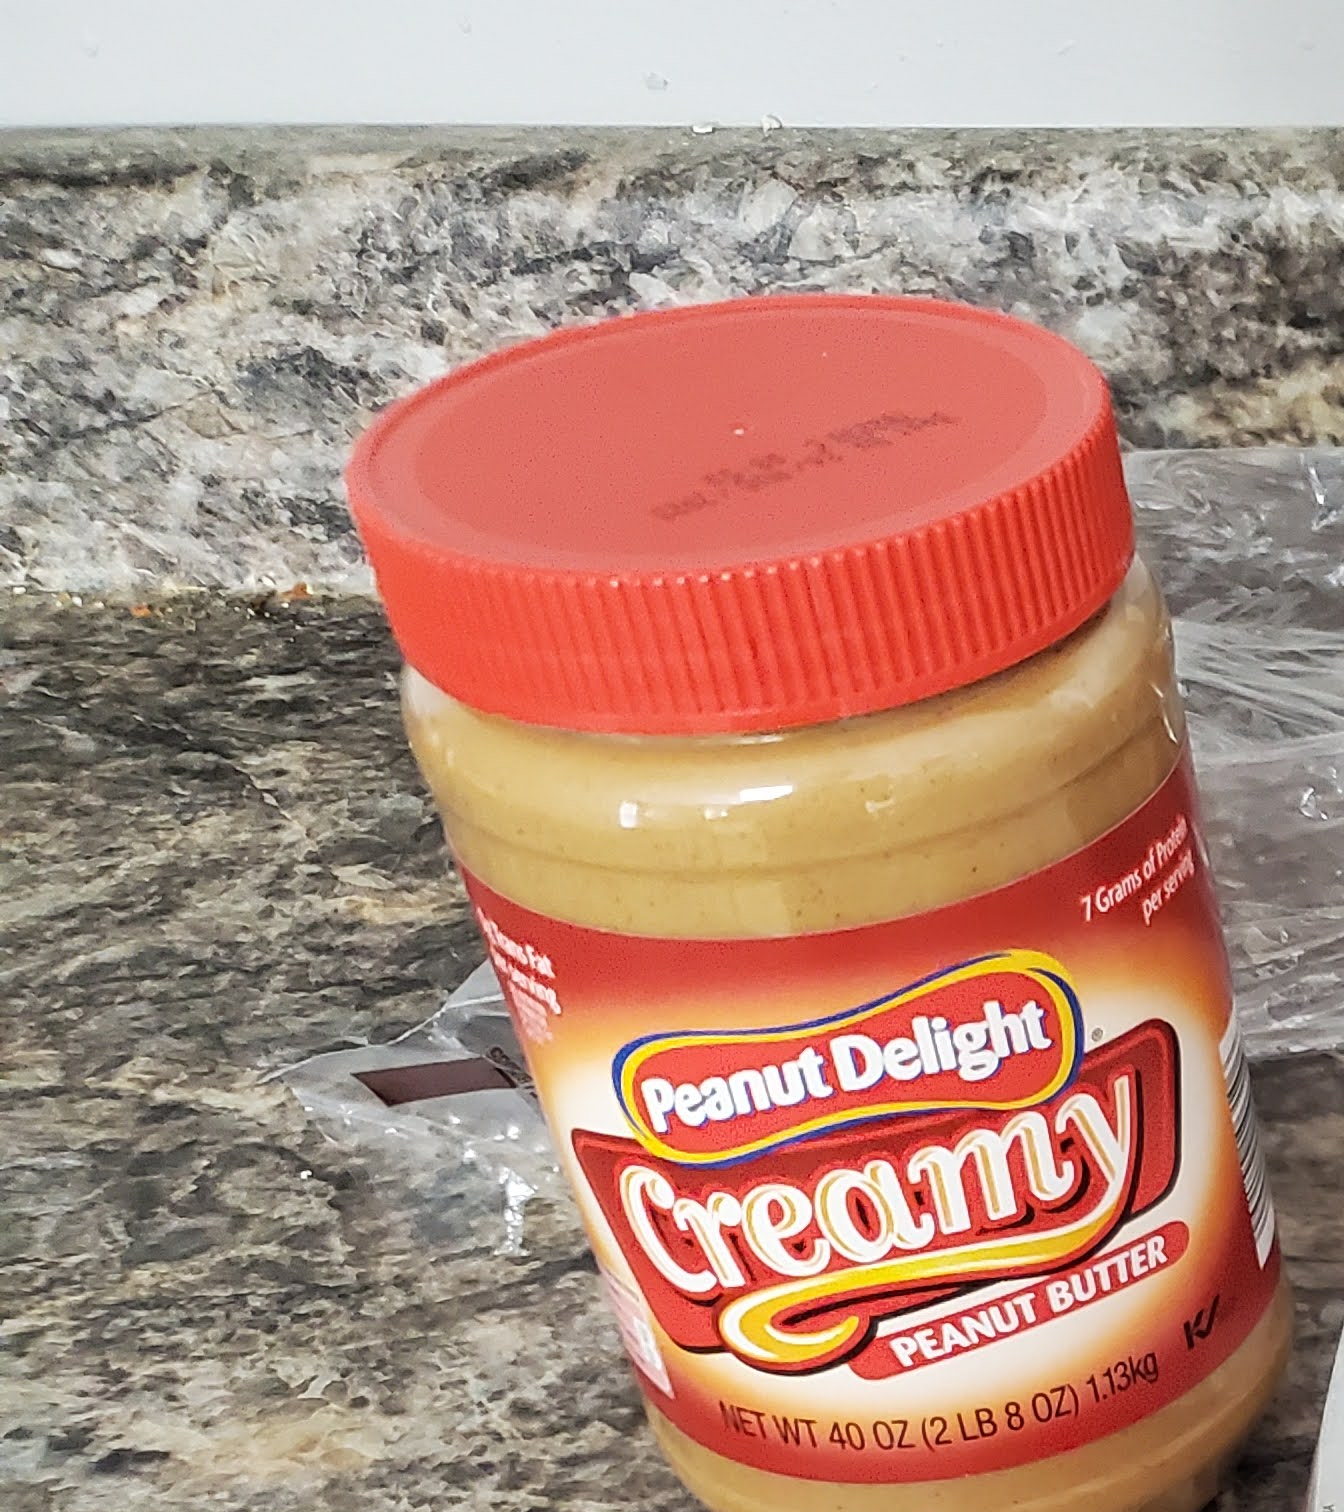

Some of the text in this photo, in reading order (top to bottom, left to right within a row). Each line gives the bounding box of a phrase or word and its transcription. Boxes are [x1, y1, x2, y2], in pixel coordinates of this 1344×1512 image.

[1080, 894, 1092, 922] 7
[1094, 868, 1143, 913] Grams
[1142, 846, 1158, 881] of
[1140, 888, 1164, 926] per
[640, 999, 1053, 1134] Peanut Delight
[618, 1073, 1131, 1294] Creamy
[888, 1234, 1170, 1368] PEANUT BUTTER
[718, 1350, 1161, 1454] NET WT 40 OZ (2 LB 8 OZ) 1.13kg
